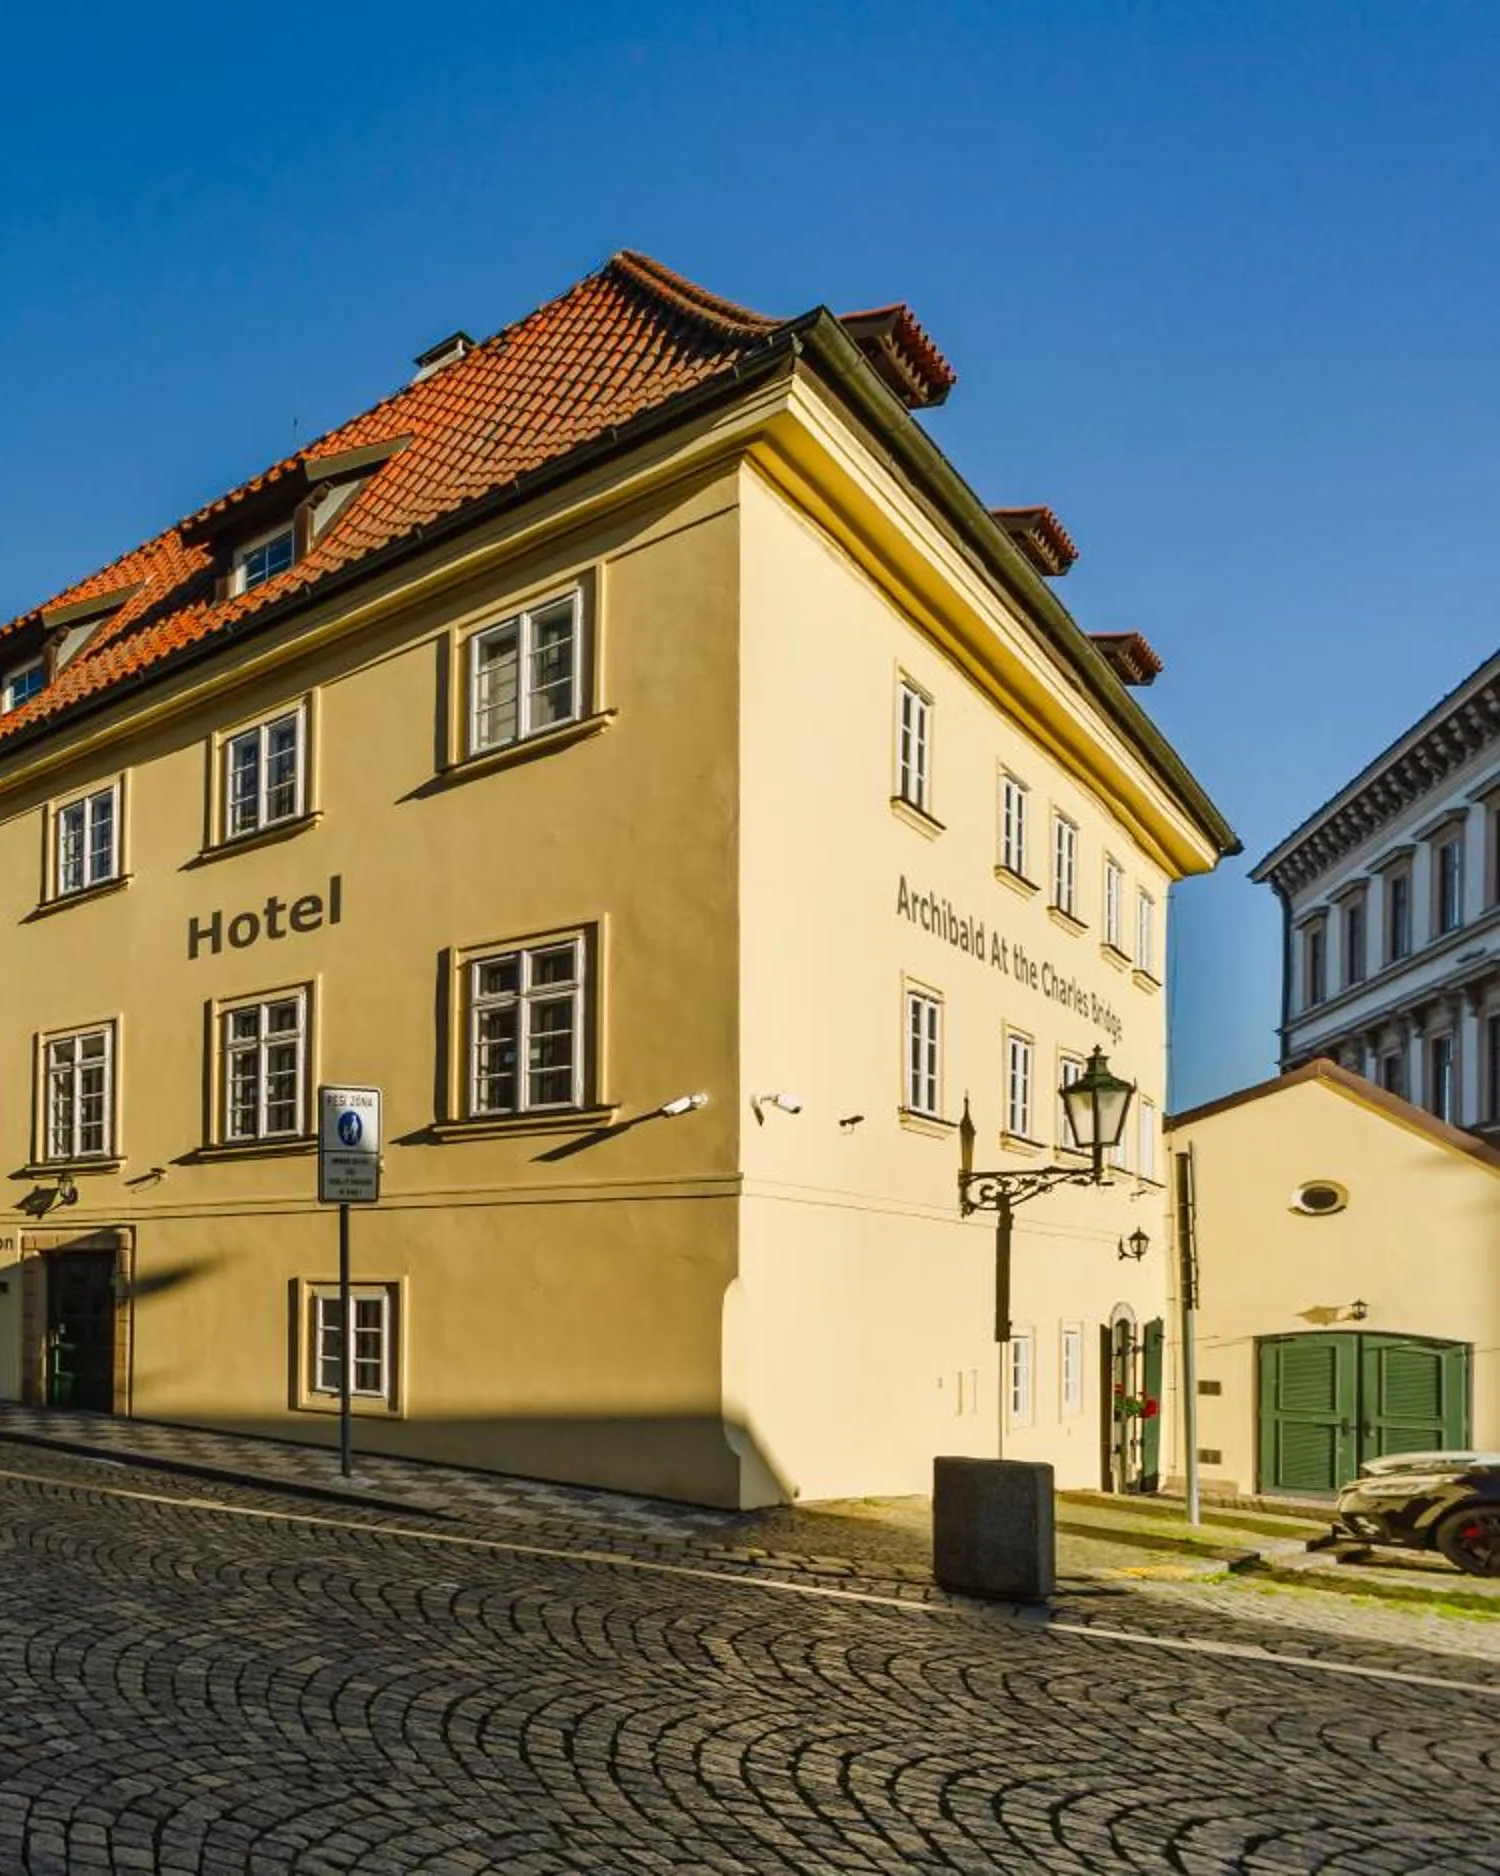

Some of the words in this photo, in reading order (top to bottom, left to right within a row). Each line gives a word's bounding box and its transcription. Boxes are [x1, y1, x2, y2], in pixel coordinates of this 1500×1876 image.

[188, 875, 342, 960] Hotel
[897, 875, 986, 962] Archibald
[991, 932, 1009, 975] At
[1014, 945, 1038, 990] the
[1041, 962, 1089, 1018] Charles
[1091, 992, 1122, 1045] Bridge
